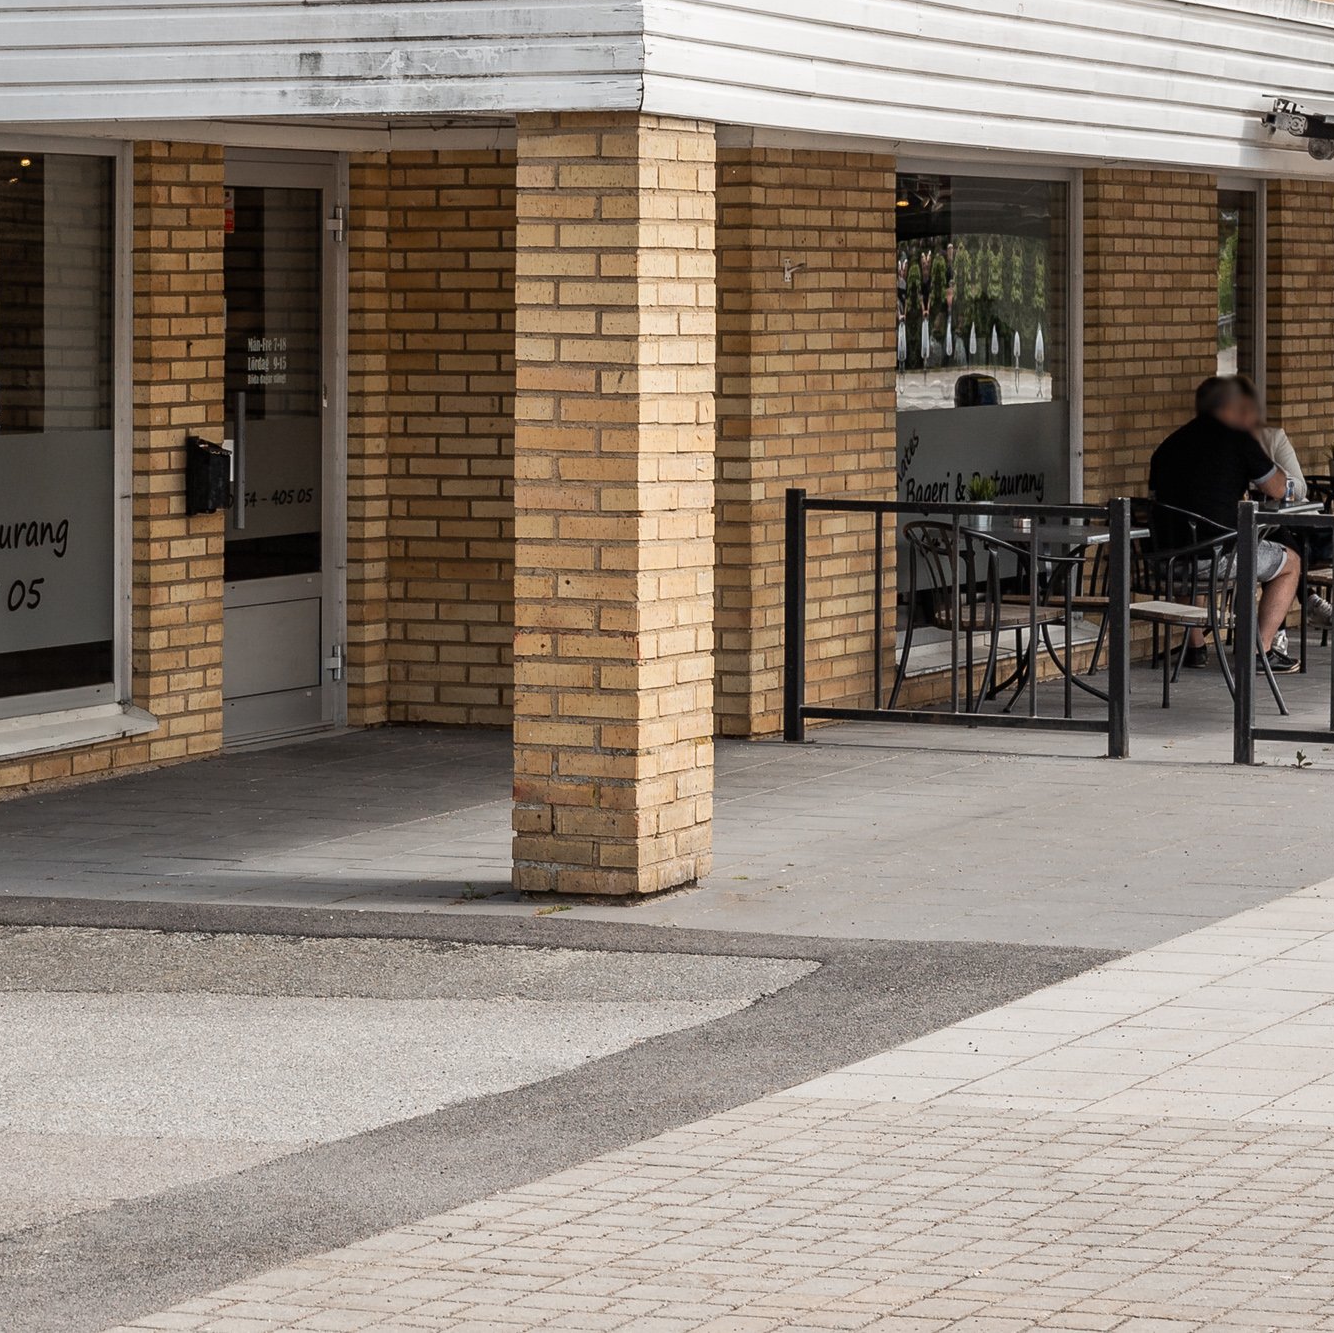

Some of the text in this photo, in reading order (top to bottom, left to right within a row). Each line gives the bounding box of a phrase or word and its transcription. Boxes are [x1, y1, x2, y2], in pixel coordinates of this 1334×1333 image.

[271, 489, 295, 506] 405
[297, 488, 314, 504] 05
[955, 472, 966, 502] &
[971, 470, 1045, 503] taurang
[7, 577, 45, 612] 05
